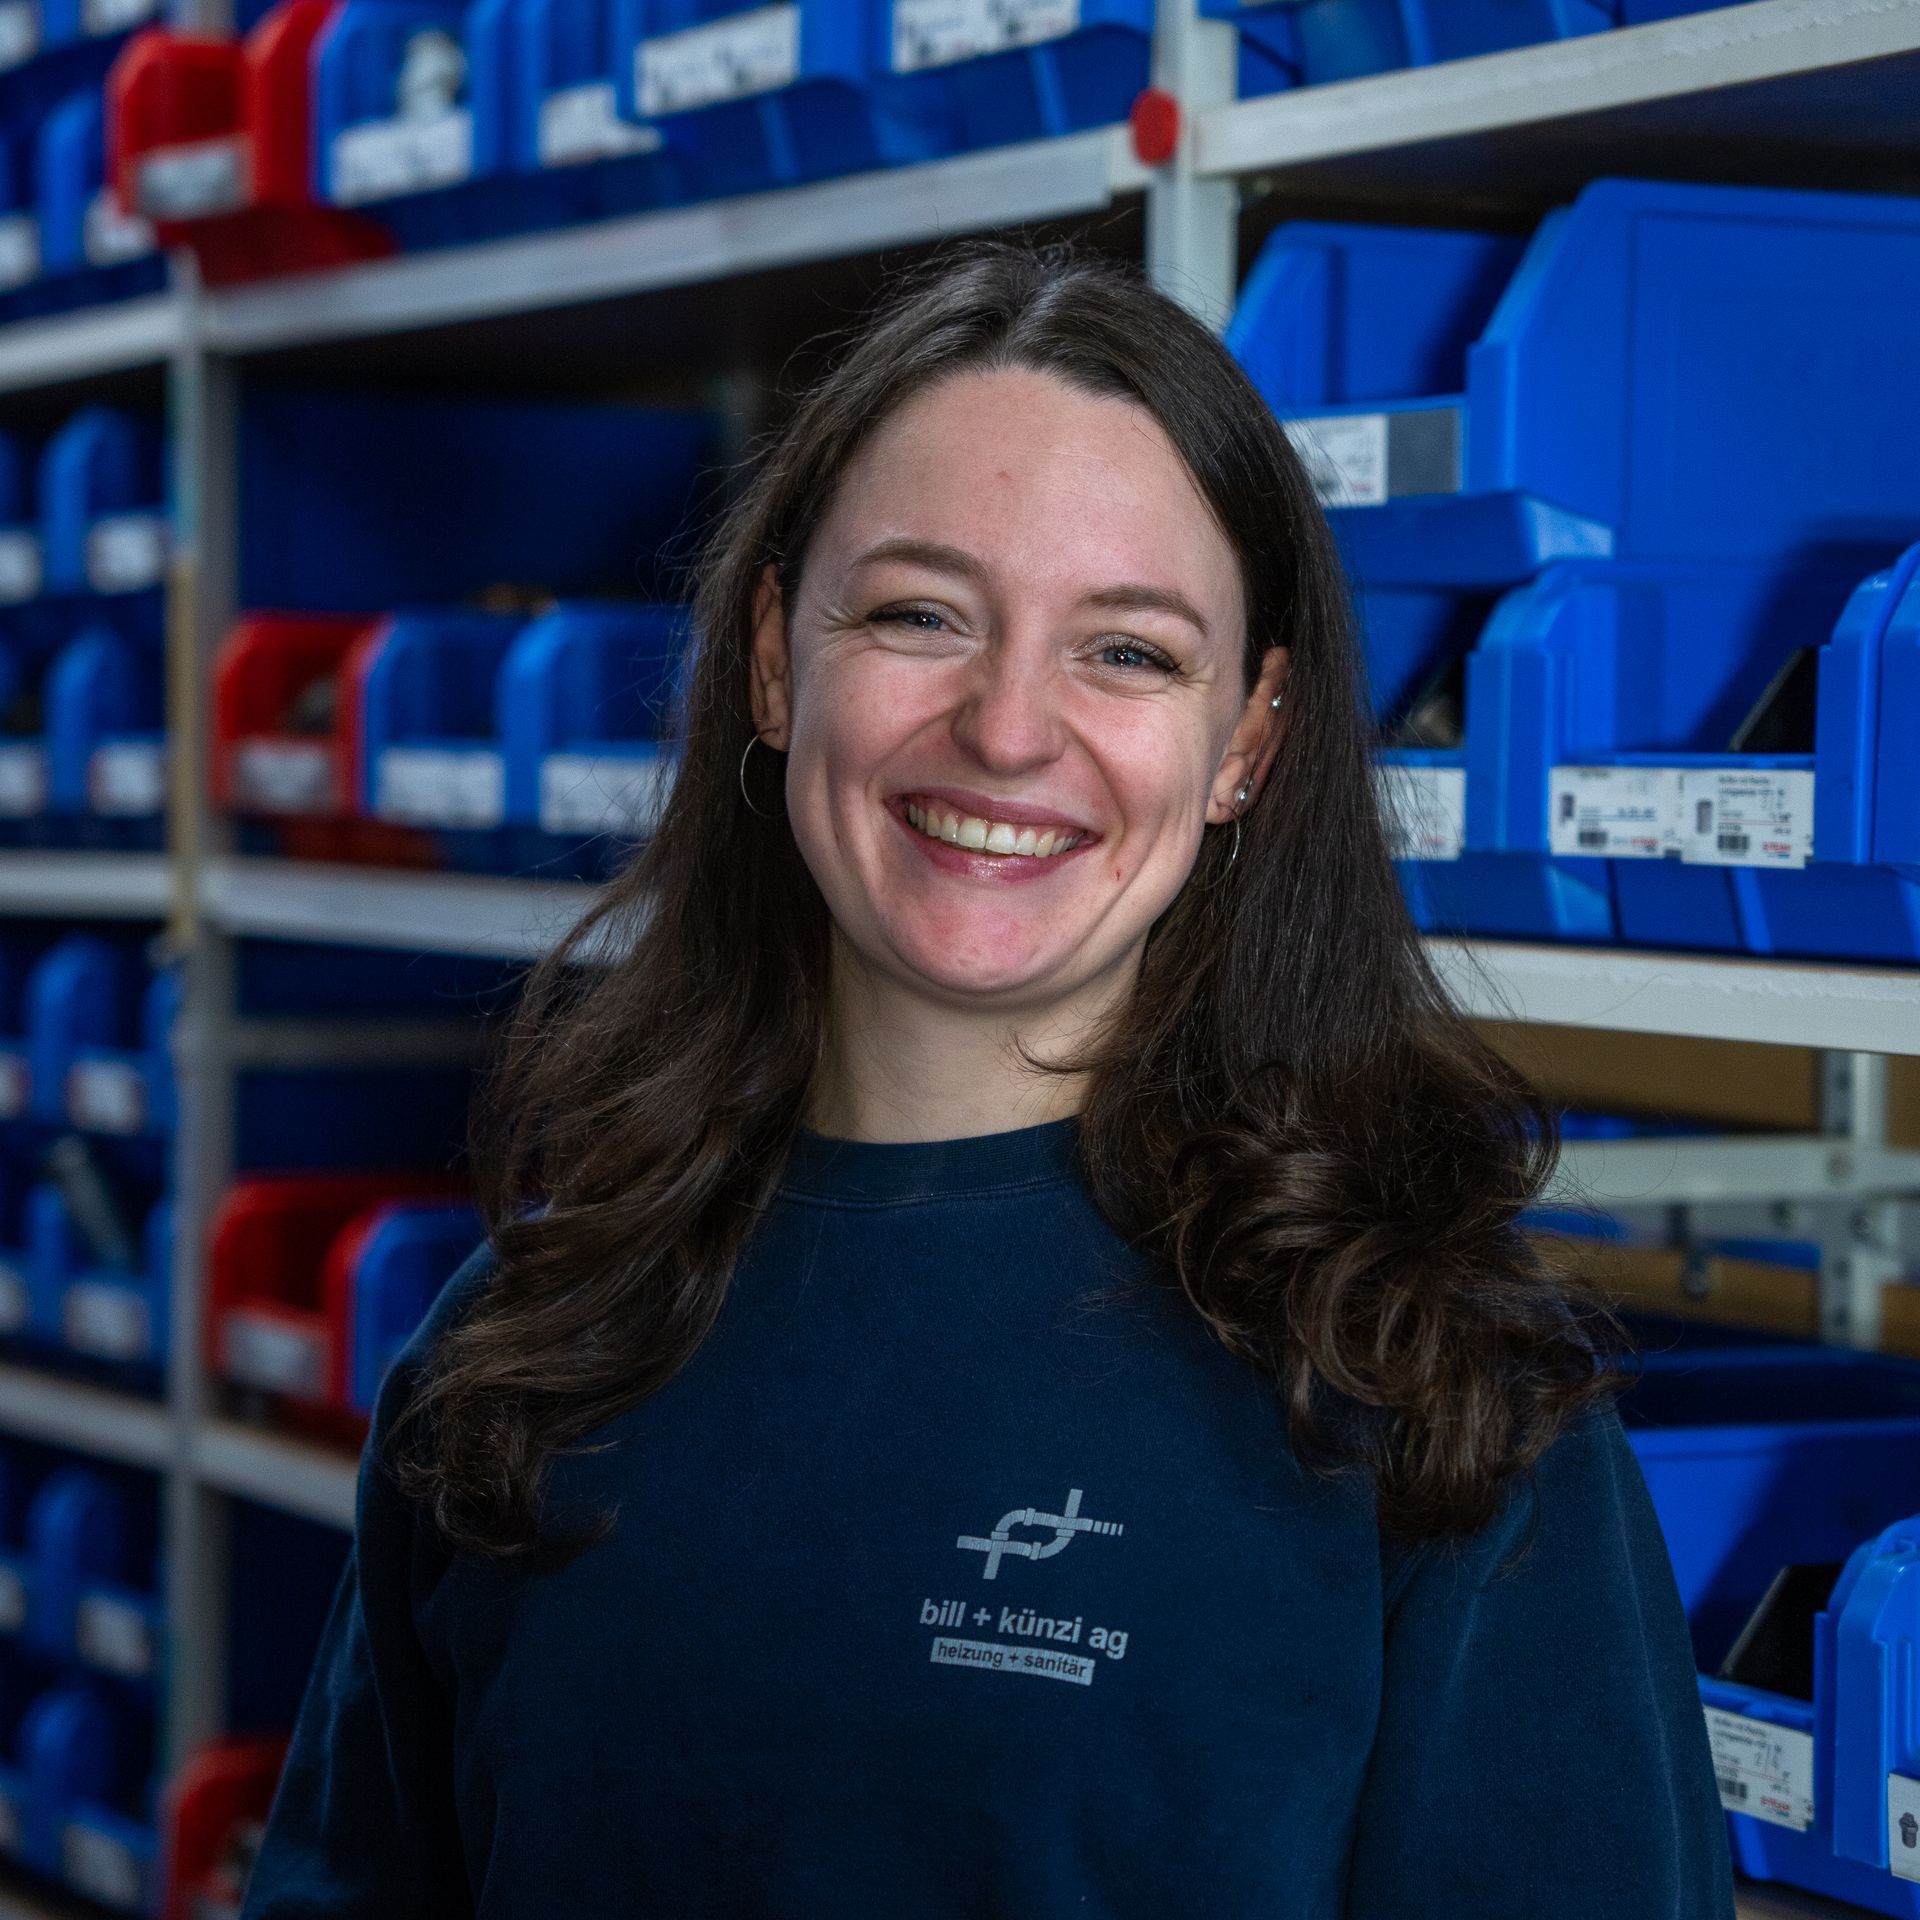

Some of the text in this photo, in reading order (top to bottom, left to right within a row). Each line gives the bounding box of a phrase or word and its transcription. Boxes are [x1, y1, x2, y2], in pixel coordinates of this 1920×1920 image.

[920, 1598, 966, 1627] bill
[998, 1606, 1083, 1643] künzi
[1088, 1626, 1129, 1660] ag
[938, 1642, 1004, 1667] heizung
[1024, 1652, 1087, 1678] sanitär
